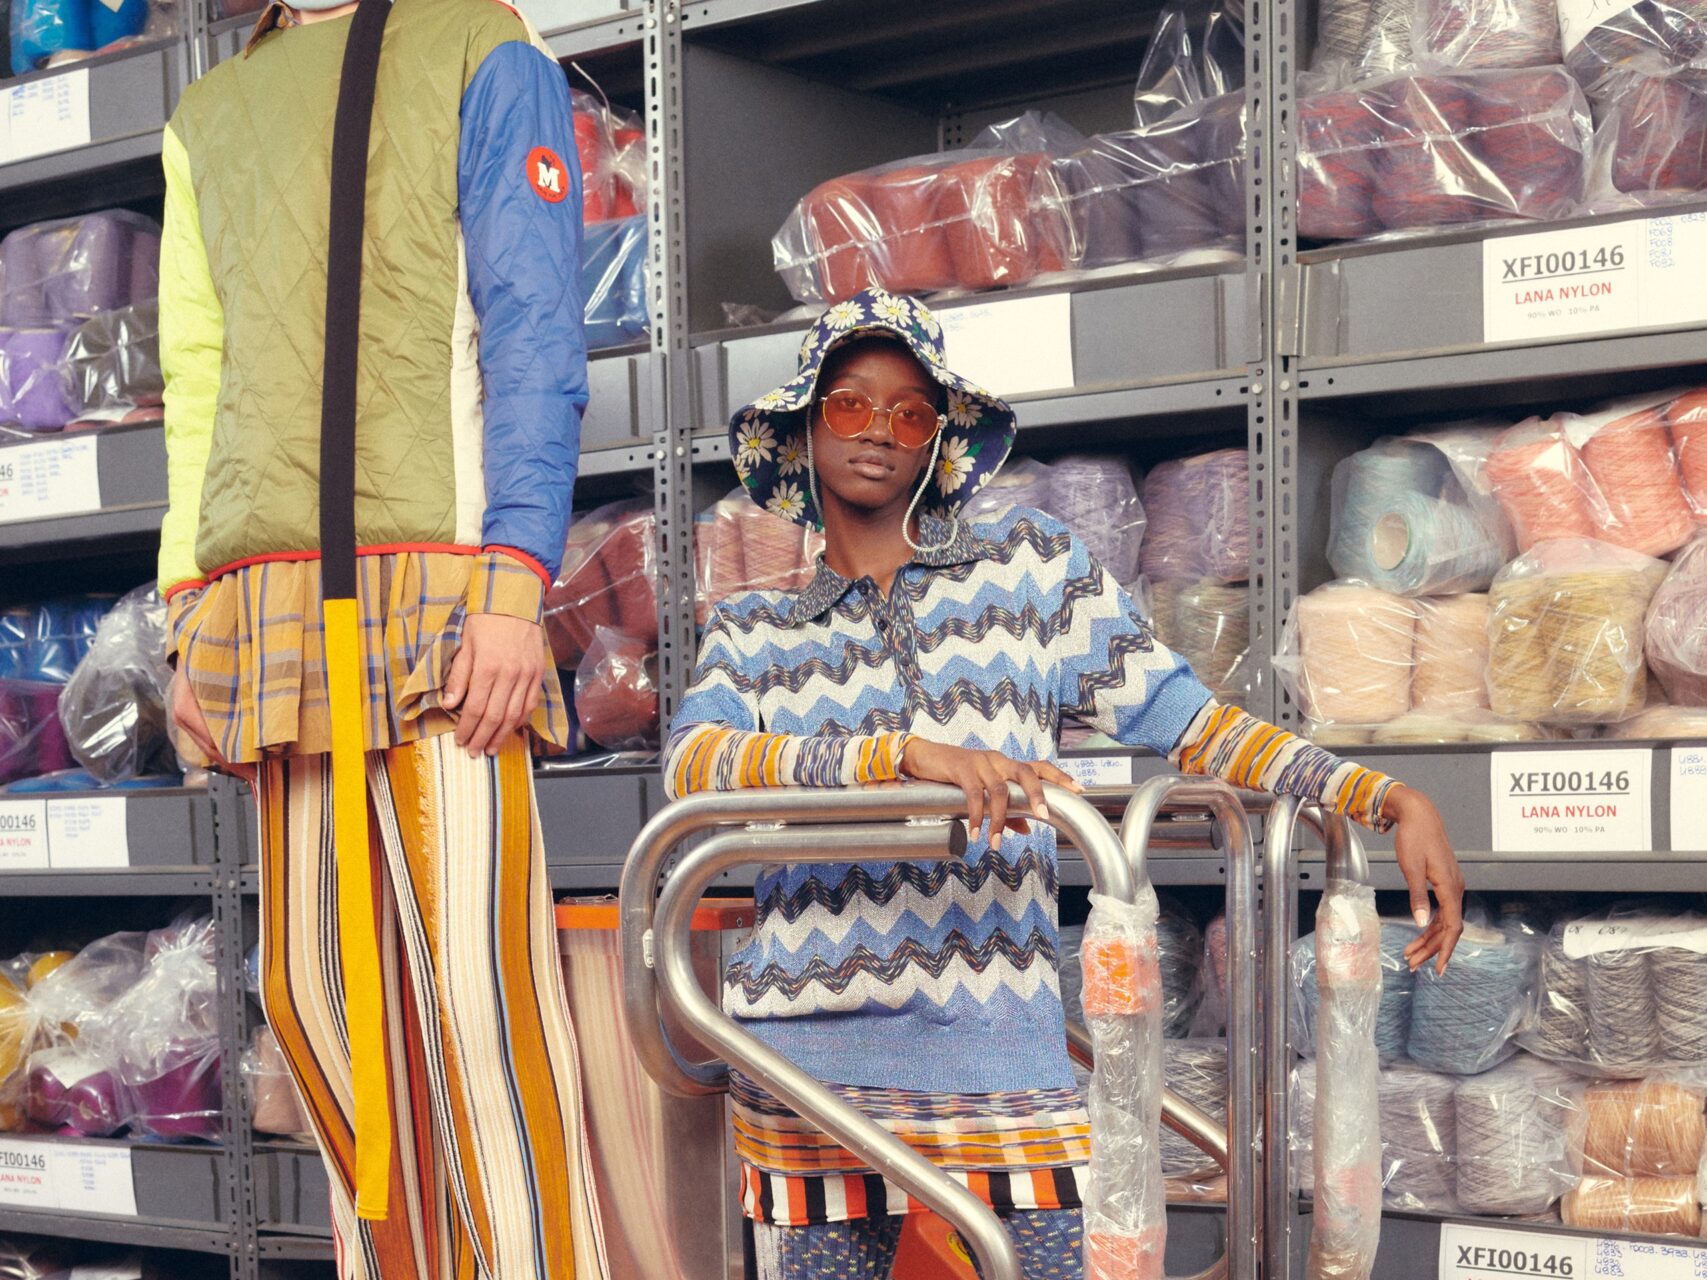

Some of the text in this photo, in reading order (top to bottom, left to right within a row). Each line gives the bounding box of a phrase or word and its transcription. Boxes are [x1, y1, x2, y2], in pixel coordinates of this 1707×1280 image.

[537, 161, 560, 193] M
[1502, 244, 1624, 280] XFI00146
[1515, 282, 1612, 305] LANA NYLON
[1527, 304, 1600, 320] 90% WO 10% PA
[1509, 770, 1630, 792] XFI00146
[1522, 804, 1617, 818] LANA NYLON
[1534, 826, 1552, 834] 90%
[1574, 826, 1593, 834] 10%
[1457, 1245, 1573, 1275] XFI00146
